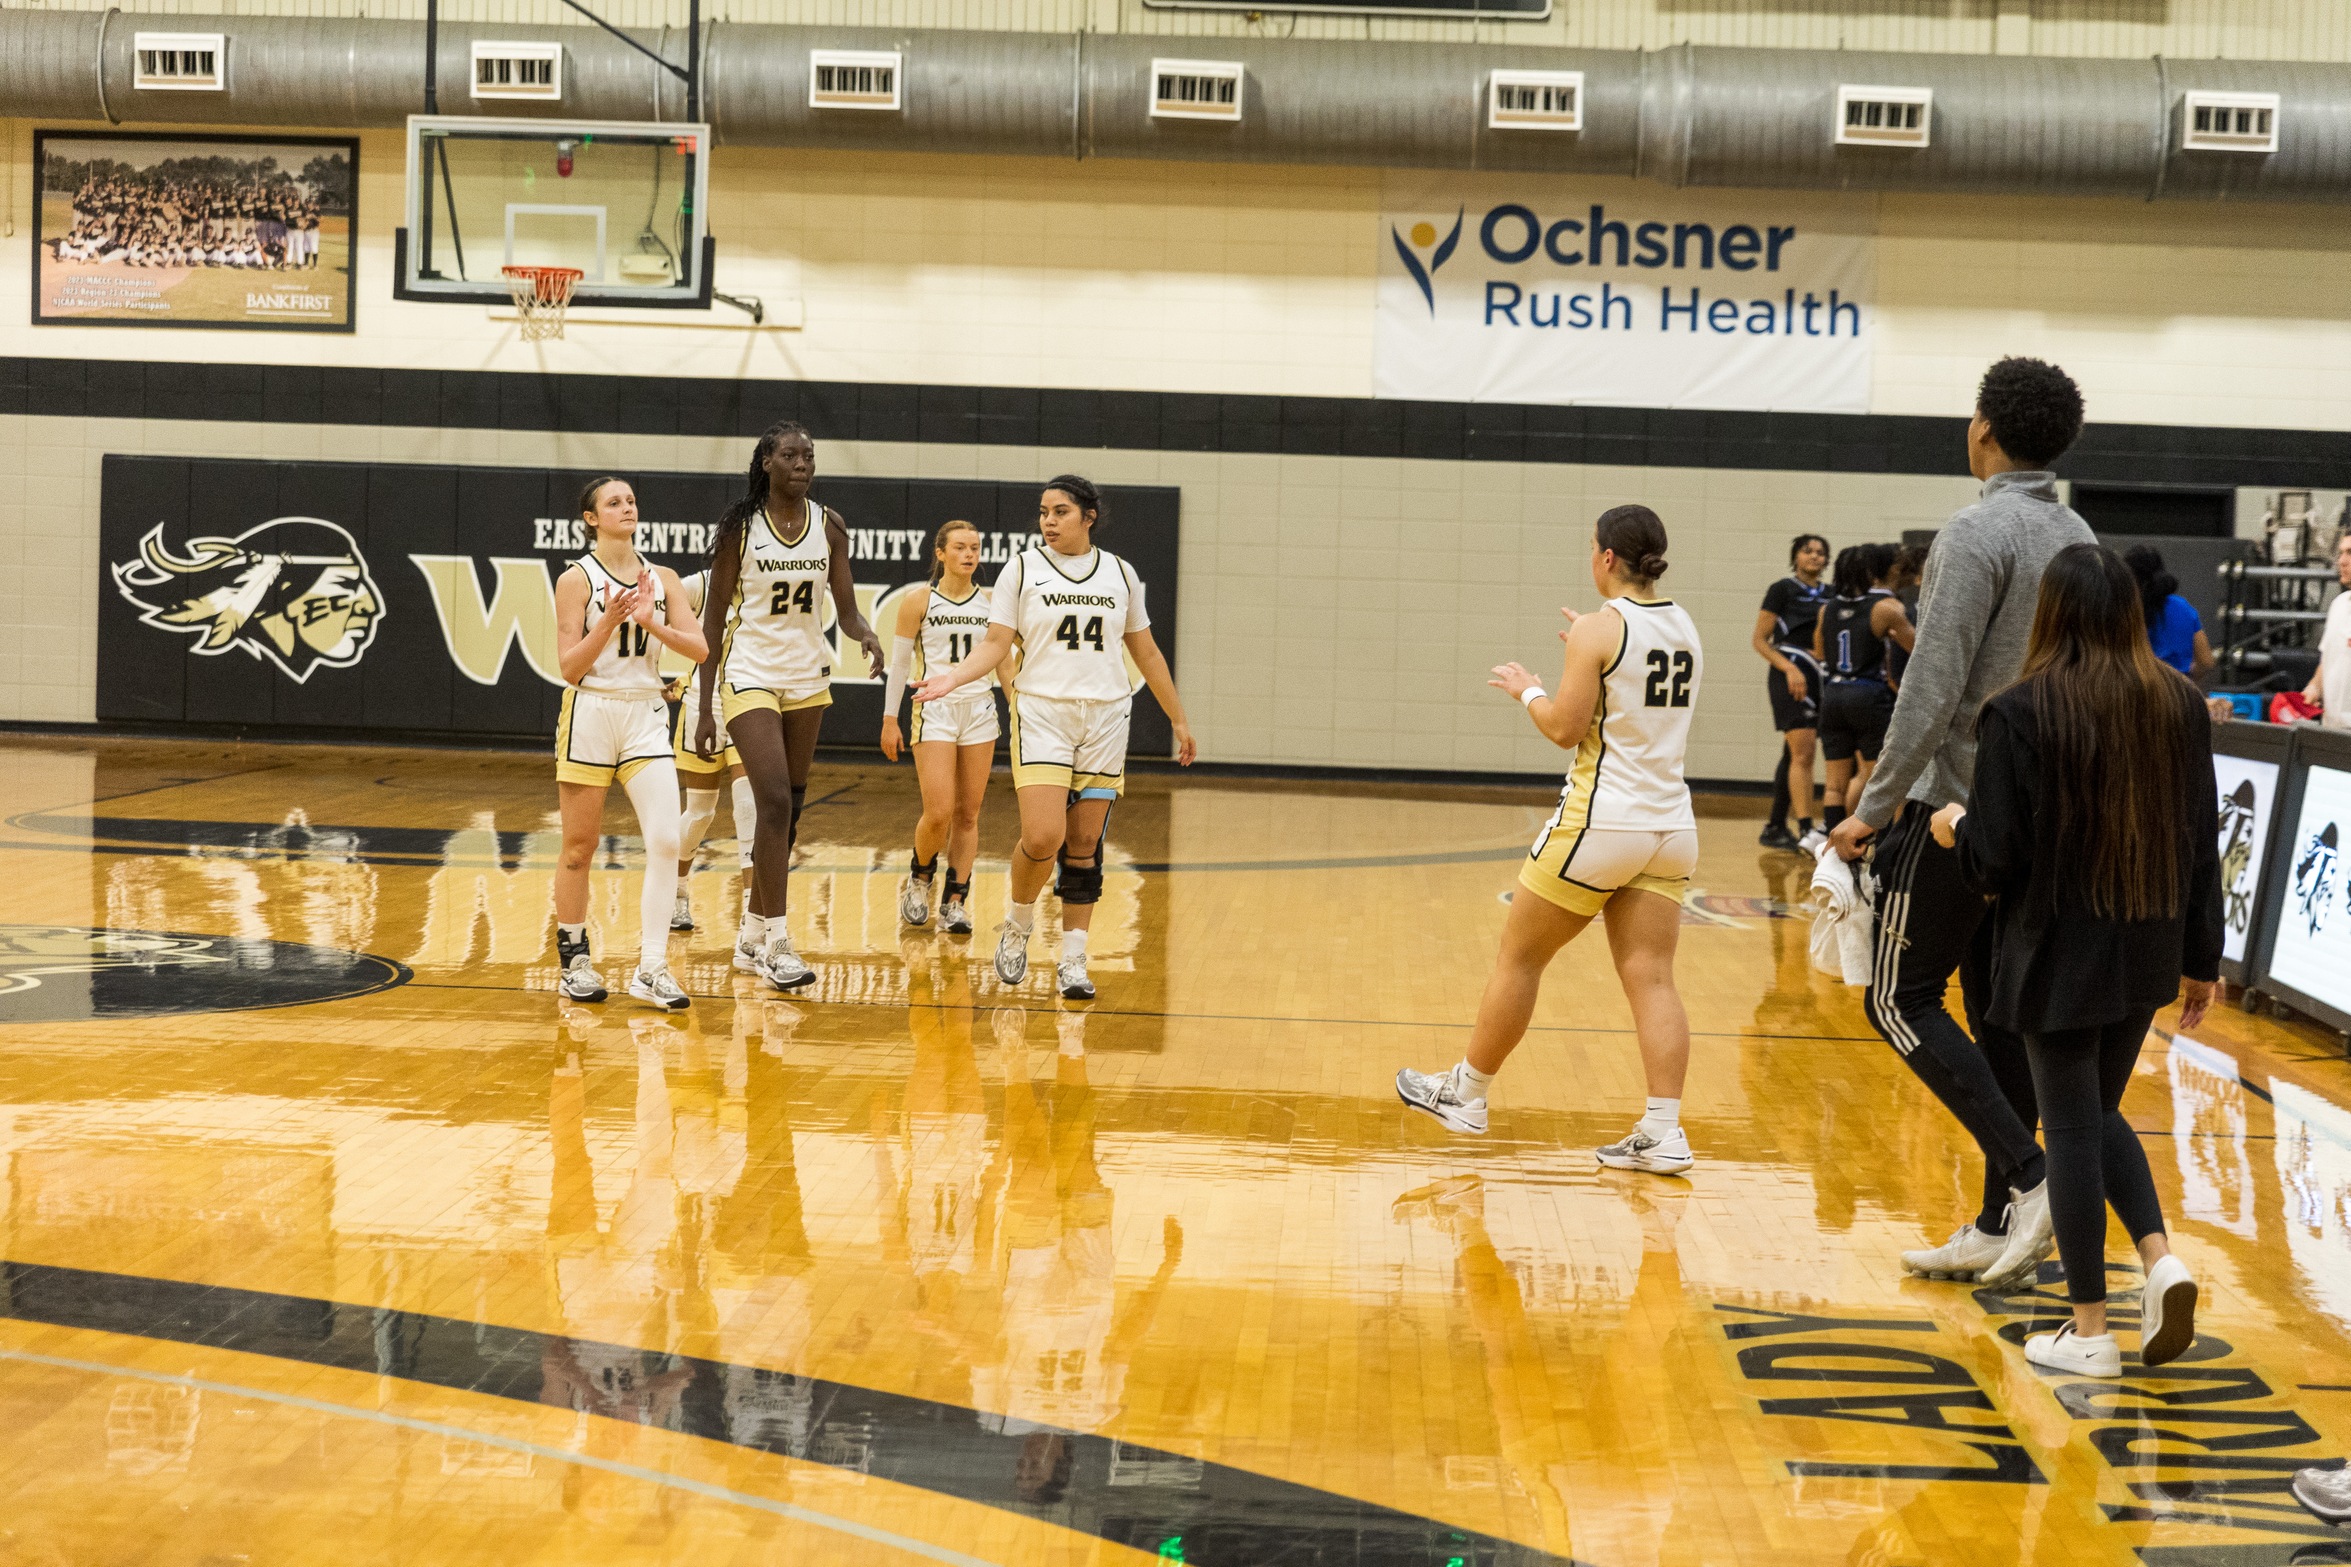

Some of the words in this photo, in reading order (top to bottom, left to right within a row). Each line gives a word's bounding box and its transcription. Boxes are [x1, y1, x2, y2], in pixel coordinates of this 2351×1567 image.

[1480, 204, 1795, 271] Ochsner
[1485, 281, 1632, 330] Rush
[1660, 286, 1860, 337] Health
[534, 518, 597, 550] EAS
[634, 521, 719, 555] ENTR
[846, 528, 926, 561] UNITY
[757, 558, 827, 573] WARRIORS
[770, 580, 814, 615] 24
[1042, 593, 1116, 609] WARRIORS
[949, 633, 972, 663] 11
[1056, 614, 1104, 651] 44
[1836, 629, 1853, 673] 1
[1644, 649, 1693, 707] 22
[1713, 1303, 2050, 1485] LADY
